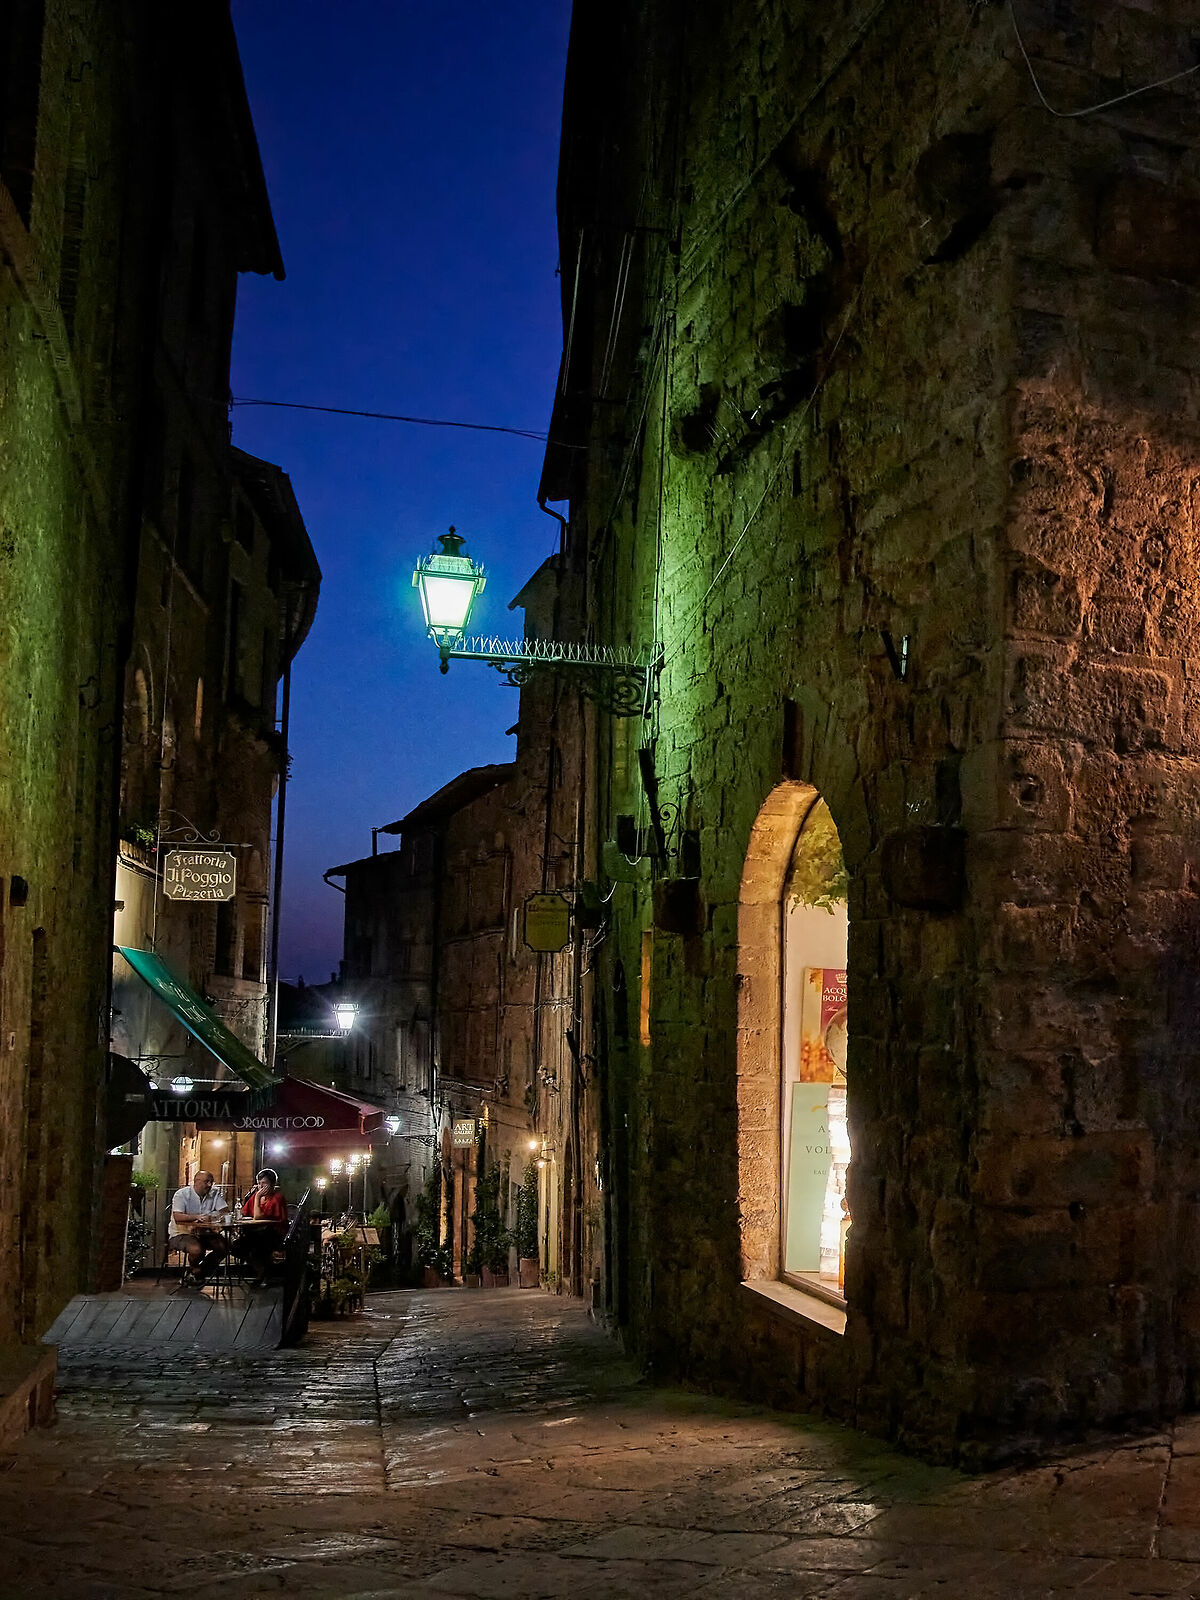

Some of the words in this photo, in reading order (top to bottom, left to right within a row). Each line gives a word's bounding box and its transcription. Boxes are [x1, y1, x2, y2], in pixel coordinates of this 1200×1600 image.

[173, 854, 227, 868] Trattoria
[181, 868, 232, 888] Poggio
[172, 884, 225, 900] Pizzeria
[285, 1116, 325, 1129] FOOD
[454, 1123, 474, 1131] ART
